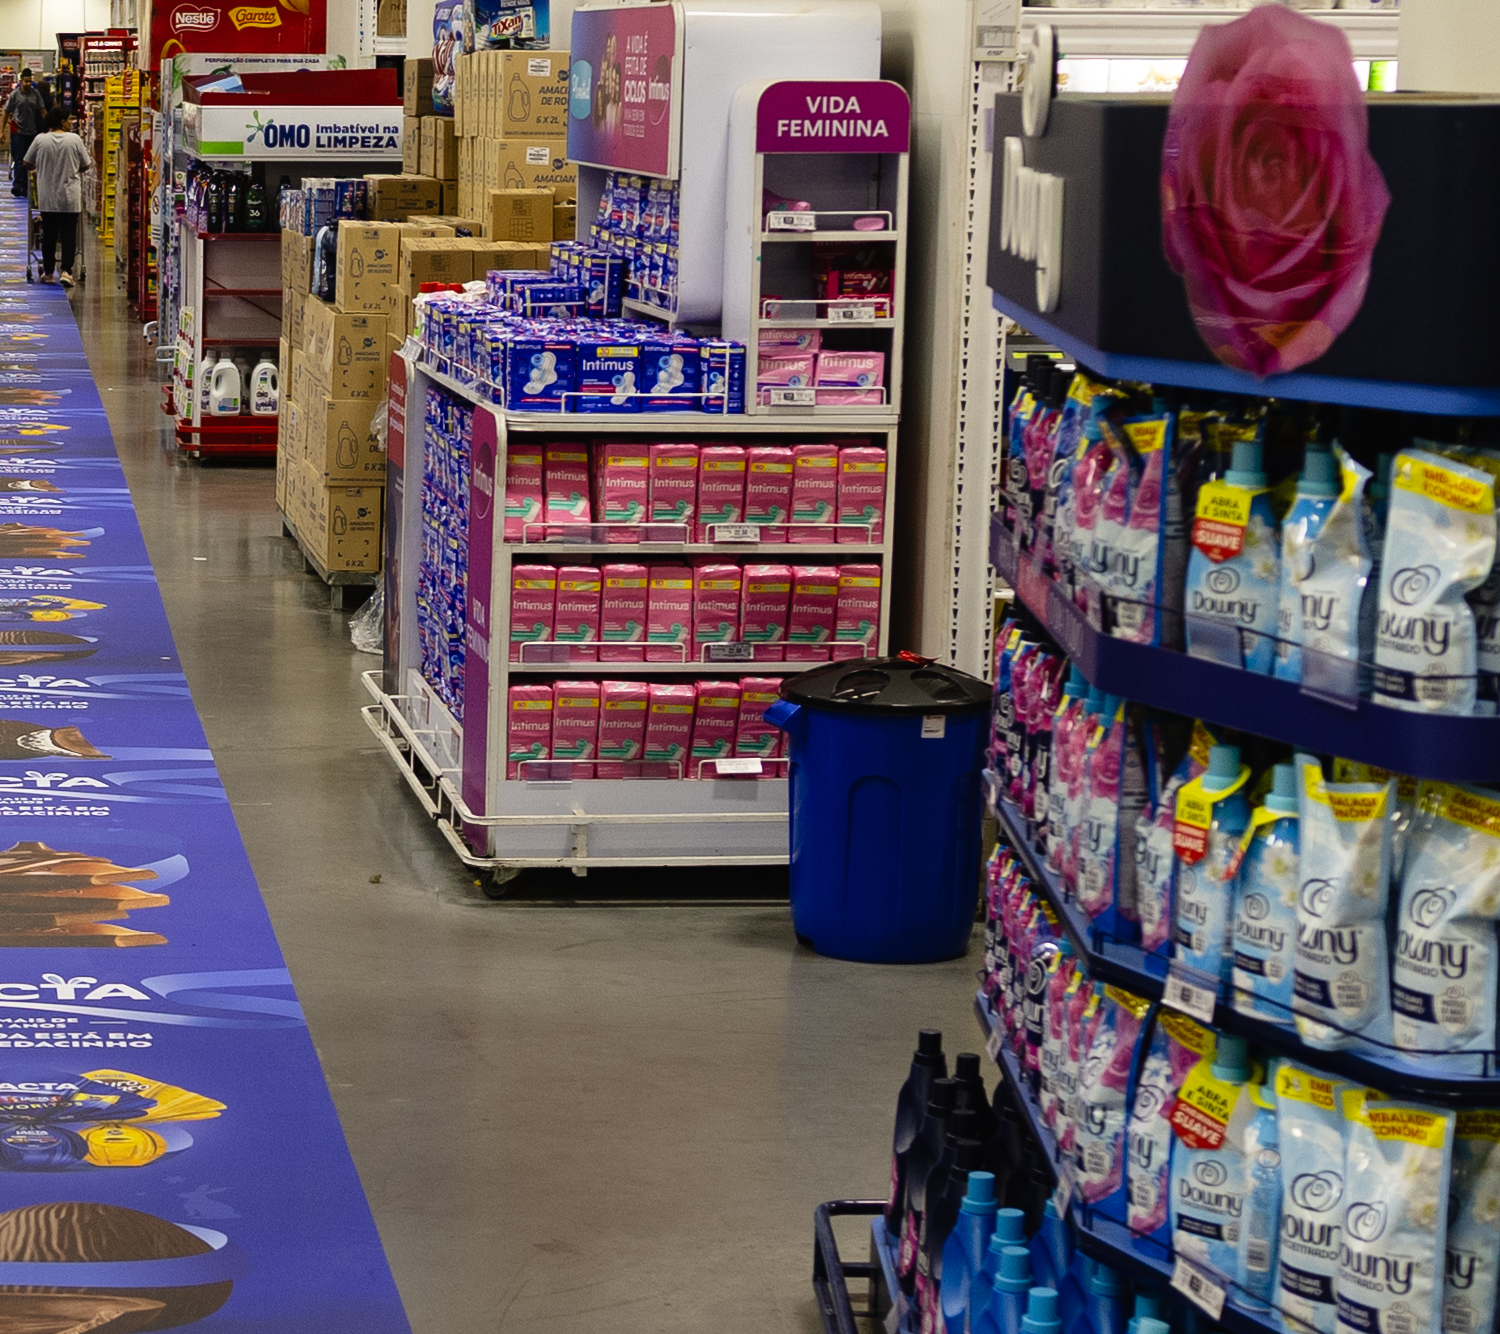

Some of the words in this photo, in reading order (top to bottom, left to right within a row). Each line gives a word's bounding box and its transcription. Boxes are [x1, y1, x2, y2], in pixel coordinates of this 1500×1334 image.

[175, 11, 216, 25] Nestlé
[236, 8, 277, 23] Garoto
[205, 56, 243, 64] PERFUMAÇÃO
[624, 80, 646, 103] CICLOS
[806, 96, 860, 114] VIDA
[264, 123, 310, 148] OMO
[316, 122, 382, 134] Imbatível
[384, 124, 399, 134] na
[776, 119, 889, 138] FEMININA
[315, 135, 398, 149] LIMPEZA
[605, 478, 646, 490] Intimus
